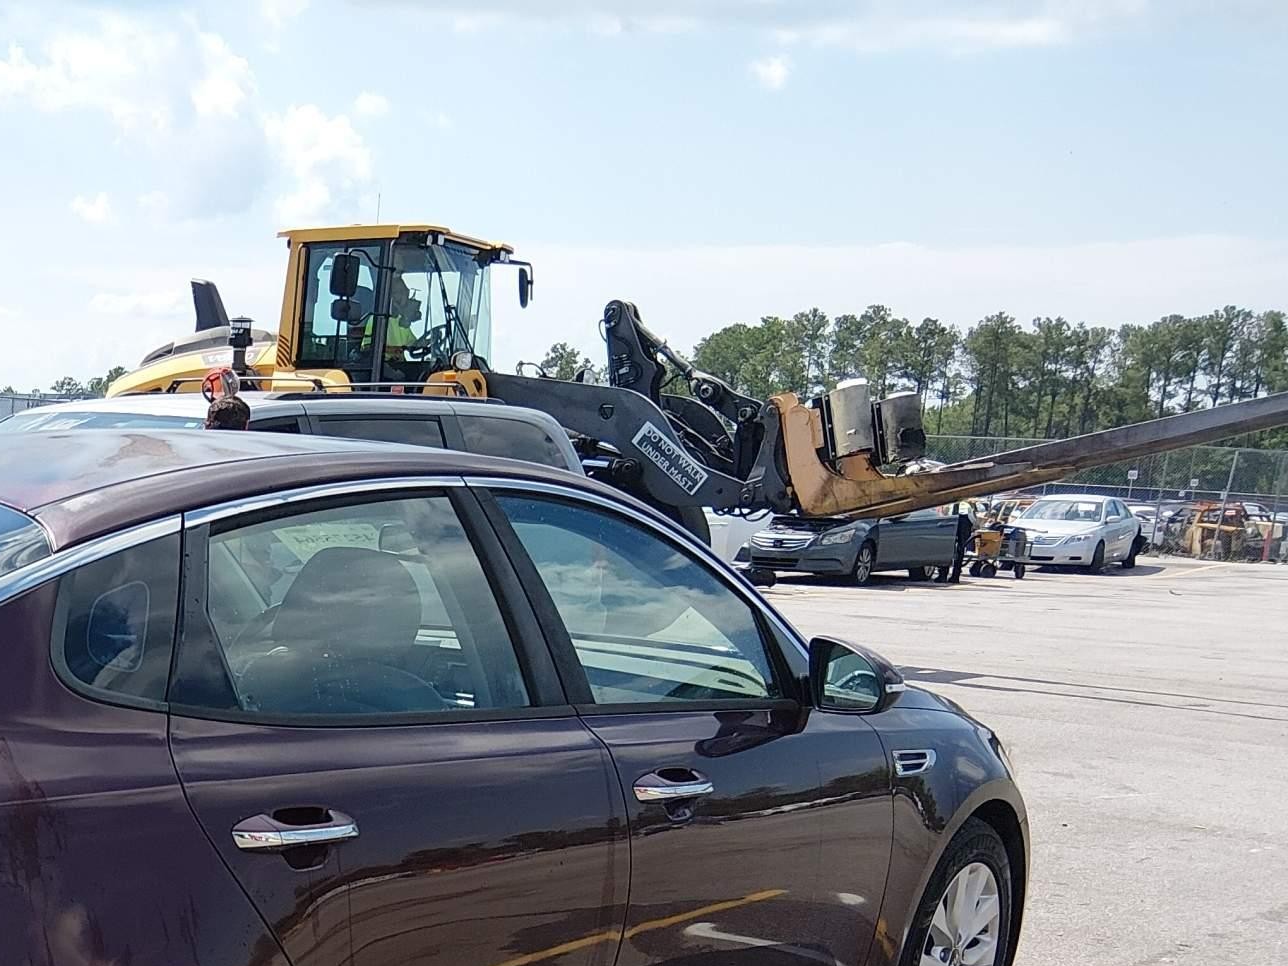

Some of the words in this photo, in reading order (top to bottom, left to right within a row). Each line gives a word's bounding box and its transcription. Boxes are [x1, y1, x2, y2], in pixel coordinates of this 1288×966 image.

[641, 442, 670, 470] UNDER
[669, 467, 693, 490] MAST
[645, 429, 659, 442] DO
[658, 440, 679, 459] NOT
[678, 457, 702, 482] WALK
